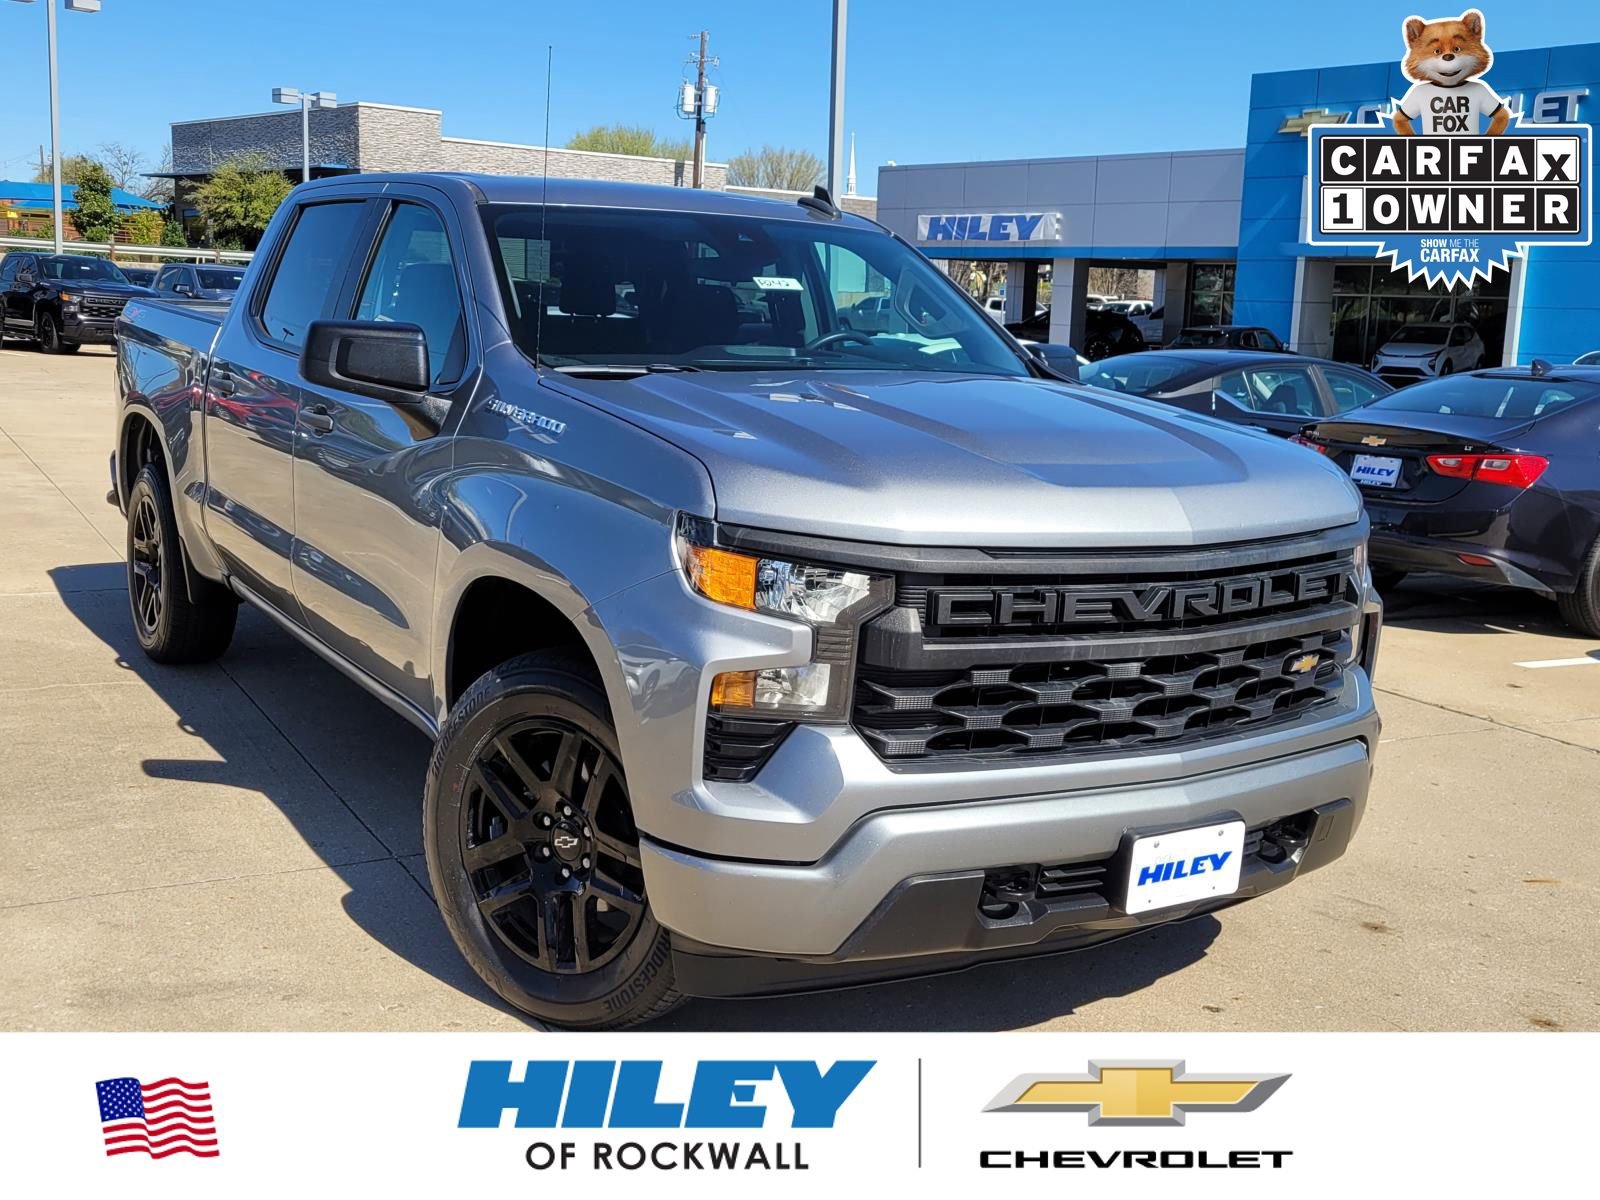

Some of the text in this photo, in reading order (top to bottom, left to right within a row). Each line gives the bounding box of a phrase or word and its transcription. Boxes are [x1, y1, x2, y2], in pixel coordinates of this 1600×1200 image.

[927, 214, 1045, 240] HILEY
[488, 398, 567, 434] SILVERADO
[1356, 466, 1395, 476] HILEY
[934, 571, 1352, 625] CHEVROLET
[1137, 850, 1233, 887] HILEY
[607, 927, 672, 1011] RIDGESTONE
